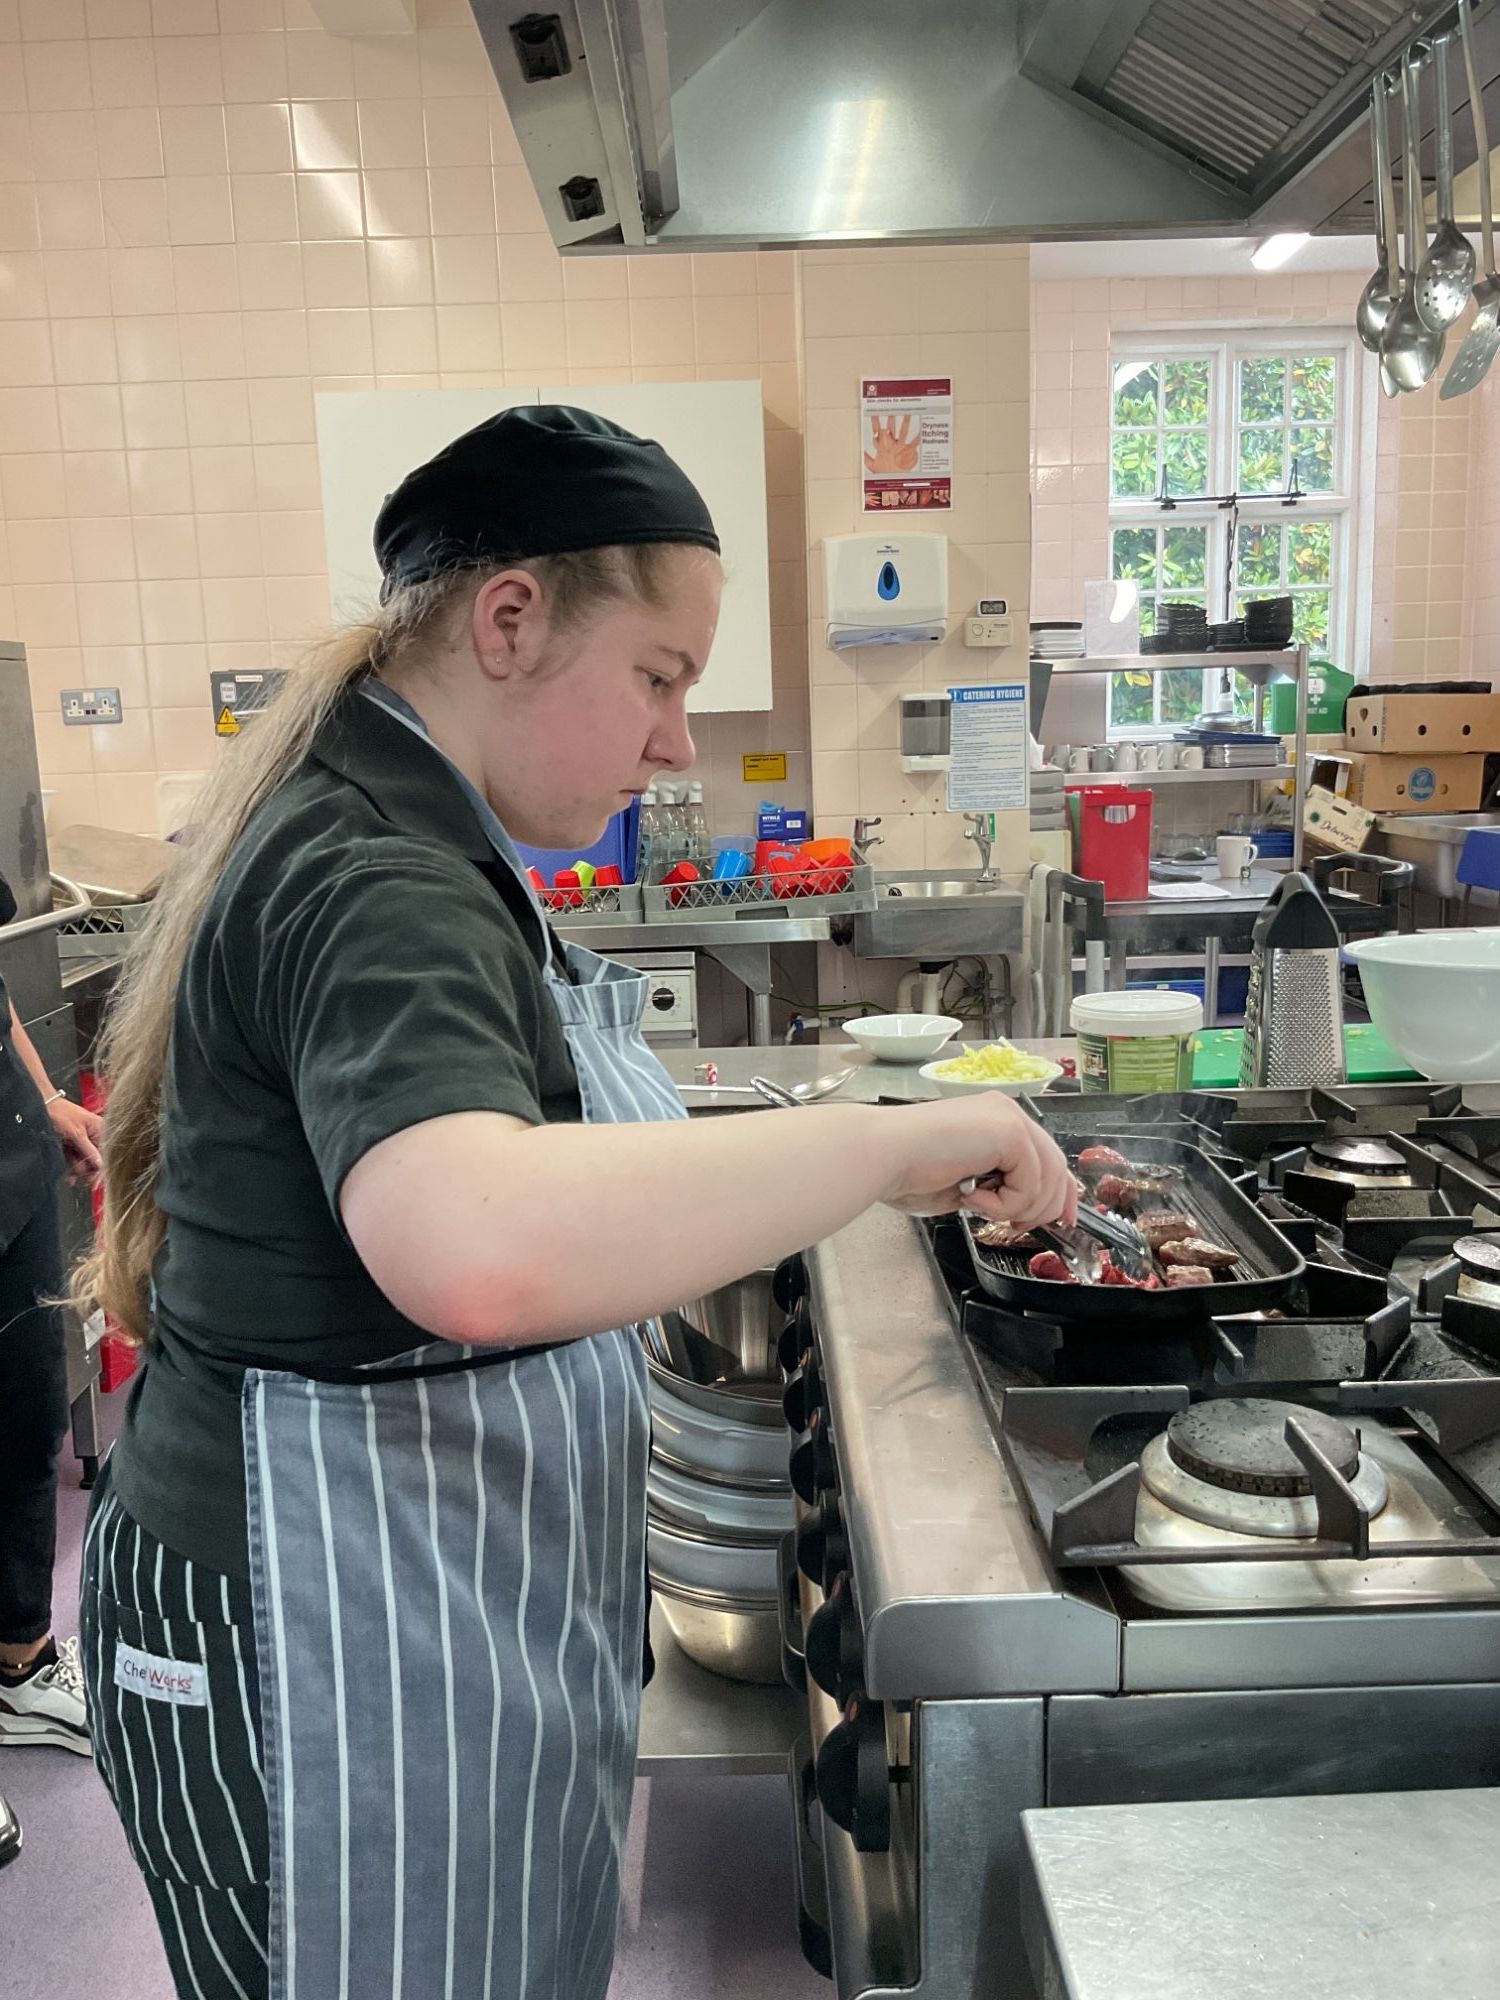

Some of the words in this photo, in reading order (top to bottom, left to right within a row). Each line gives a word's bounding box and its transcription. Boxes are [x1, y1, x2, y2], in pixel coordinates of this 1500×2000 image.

[922, 422, 949, 430] Dryness
[922, 430, 949, 438] Itching
[962, 690, 995, 700] CATERING
[996, 689, 1023, 699] HYGIENE
